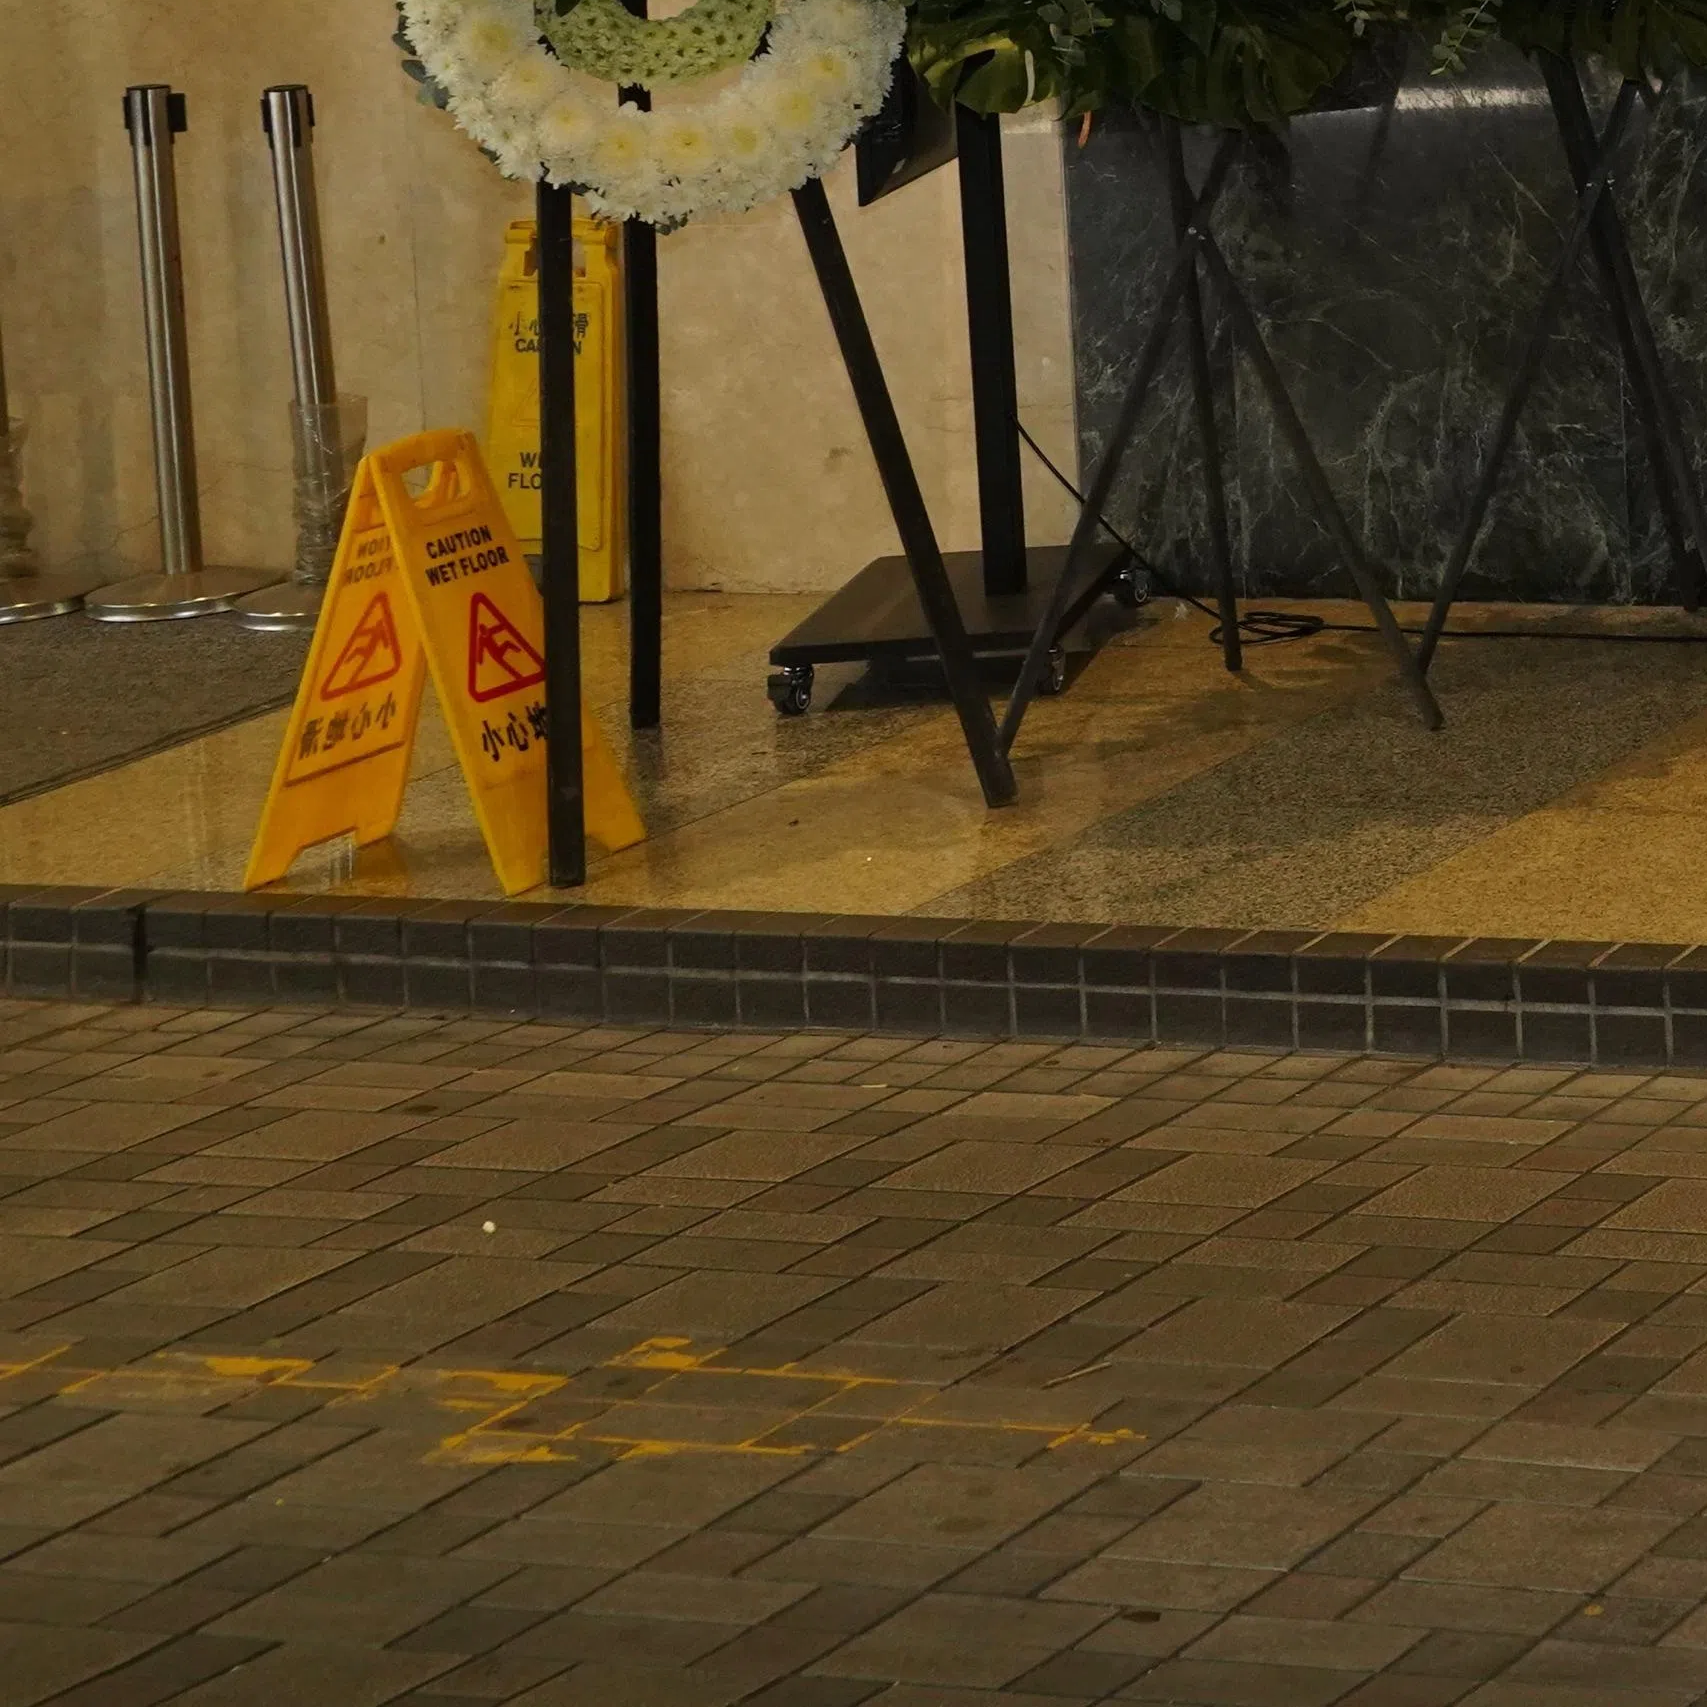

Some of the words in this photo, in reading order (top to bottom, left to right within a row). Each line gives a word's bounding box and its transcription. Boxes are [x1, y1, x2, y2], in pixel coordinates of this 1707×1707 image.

[508, 473, 542, 490] FLO
[426, 525, 493, 559] CAUTION
[425, 562, 459, 587] WET
[458, 546, 510, 577] FLOOR
